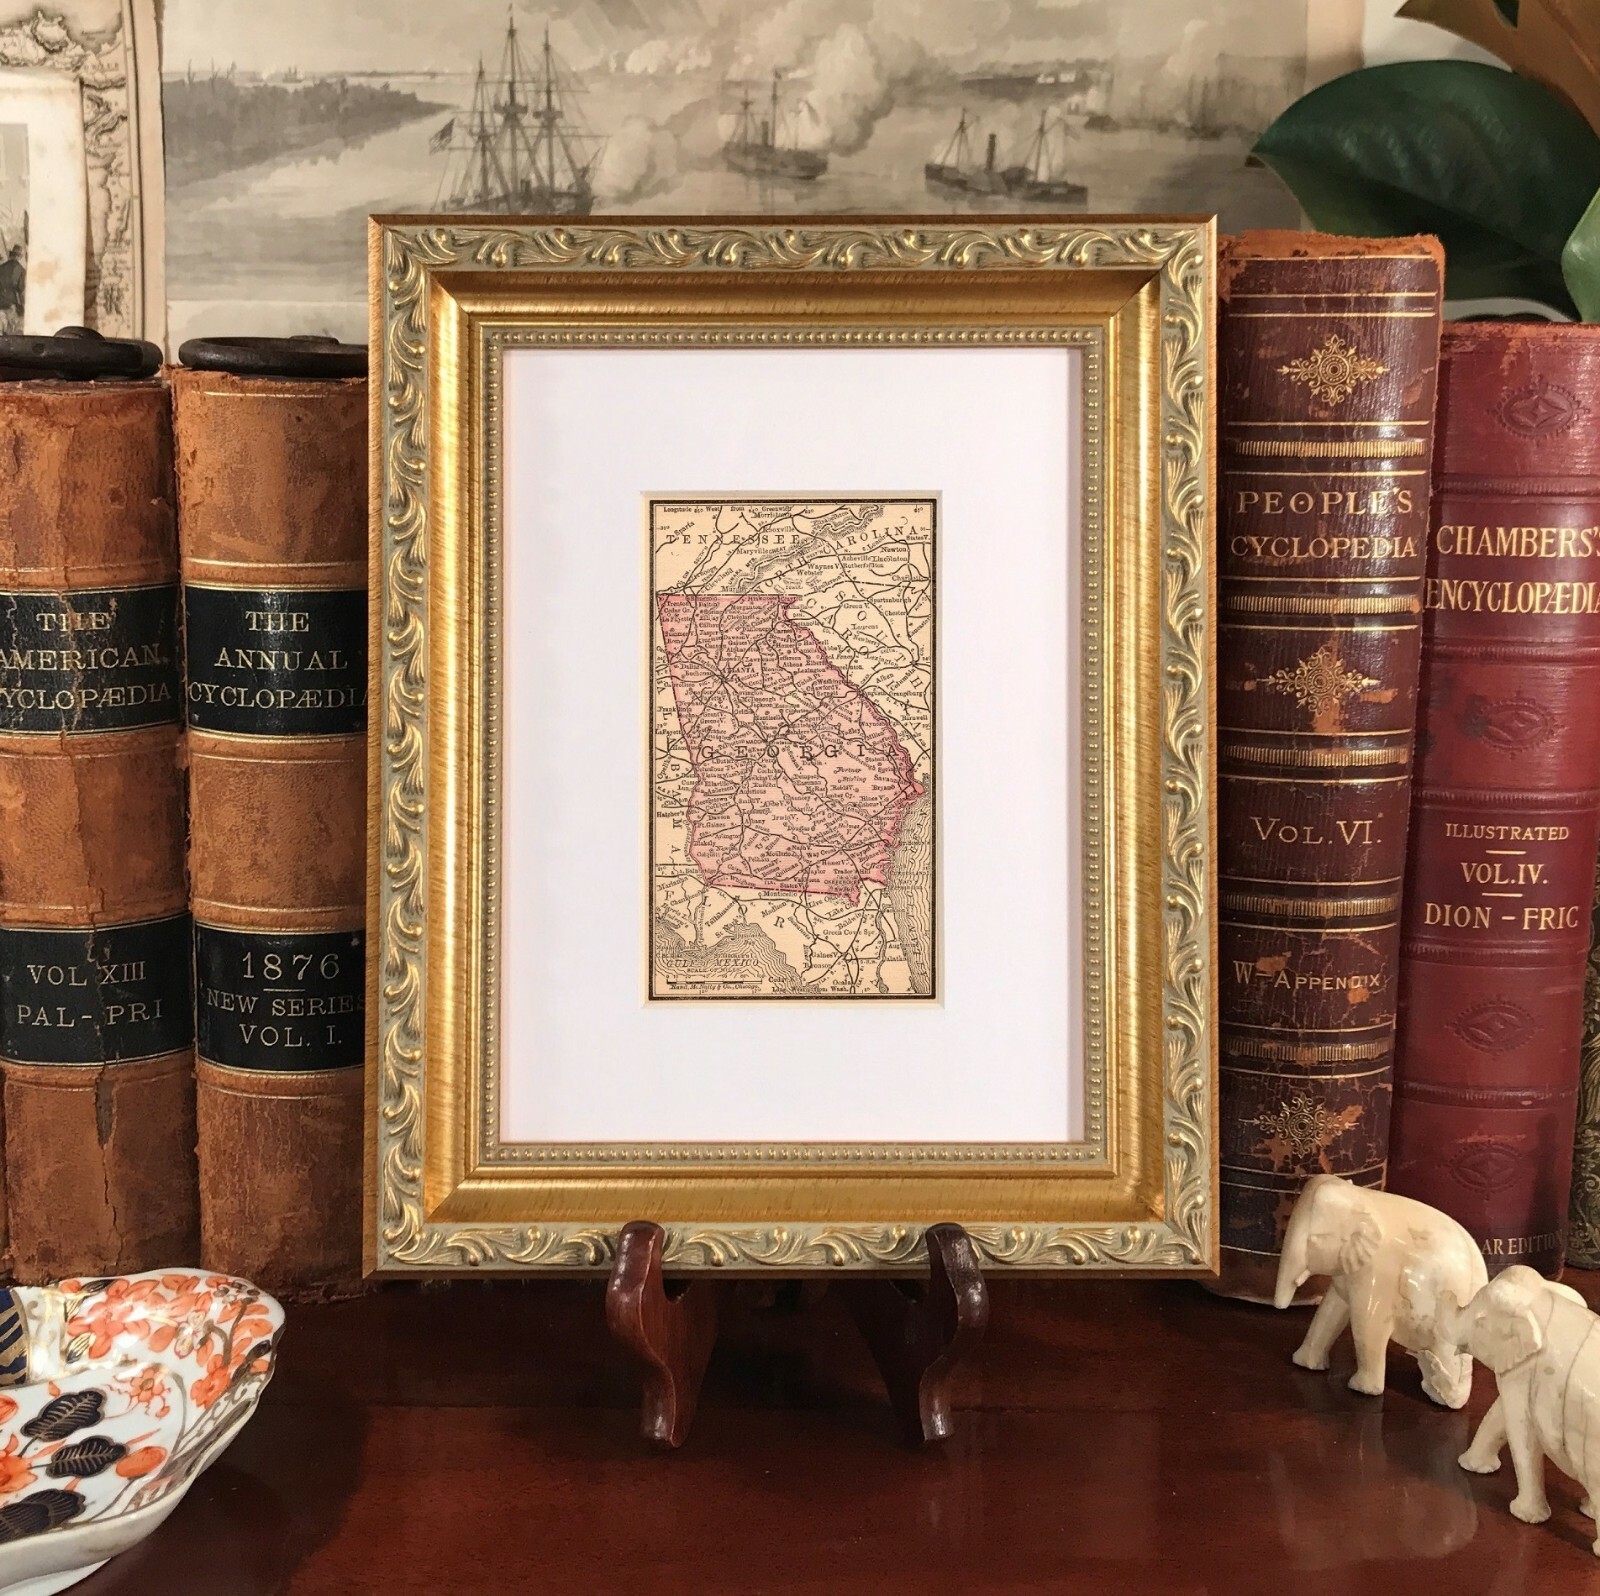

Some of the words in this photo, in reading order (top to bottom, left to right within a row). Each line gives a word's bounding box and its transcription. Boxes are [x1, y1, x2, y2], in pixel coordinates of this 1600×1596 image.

[1237, 487, 1412, 514] PEOPLE'S
[1231, 536, 1416, 558] CYCLOPEDIA
[1436, 525, 1600, 558] CHAMBERS'
[36, 612, 110, 632] THE
[246, 611, 310, 632] THE
[214, 648, 348, 670] ANNUAL
[0, 682, 171, 710] YCLOPÆDIA
[701, 744, 899, 758] GEORGIA
[1445, 822, 1570, 841] ILLUSTRATED
[1424, 902, 1490, 928] DION
[1523, 904, 1579, 930] FRIC
[27, 964, 87, 986] VOL
[100, 961, 146, 984] XIII
[242, 952, 340, 980] 1876
[106, 1000, 163, 1026] PRI
[207, 988, 258, 1013] NEW
[240, 1024, 310, 1047] VOL.
[326, 1025, 342, 1044] I.
[1508, 1229, 1563, 1254] EDITION
